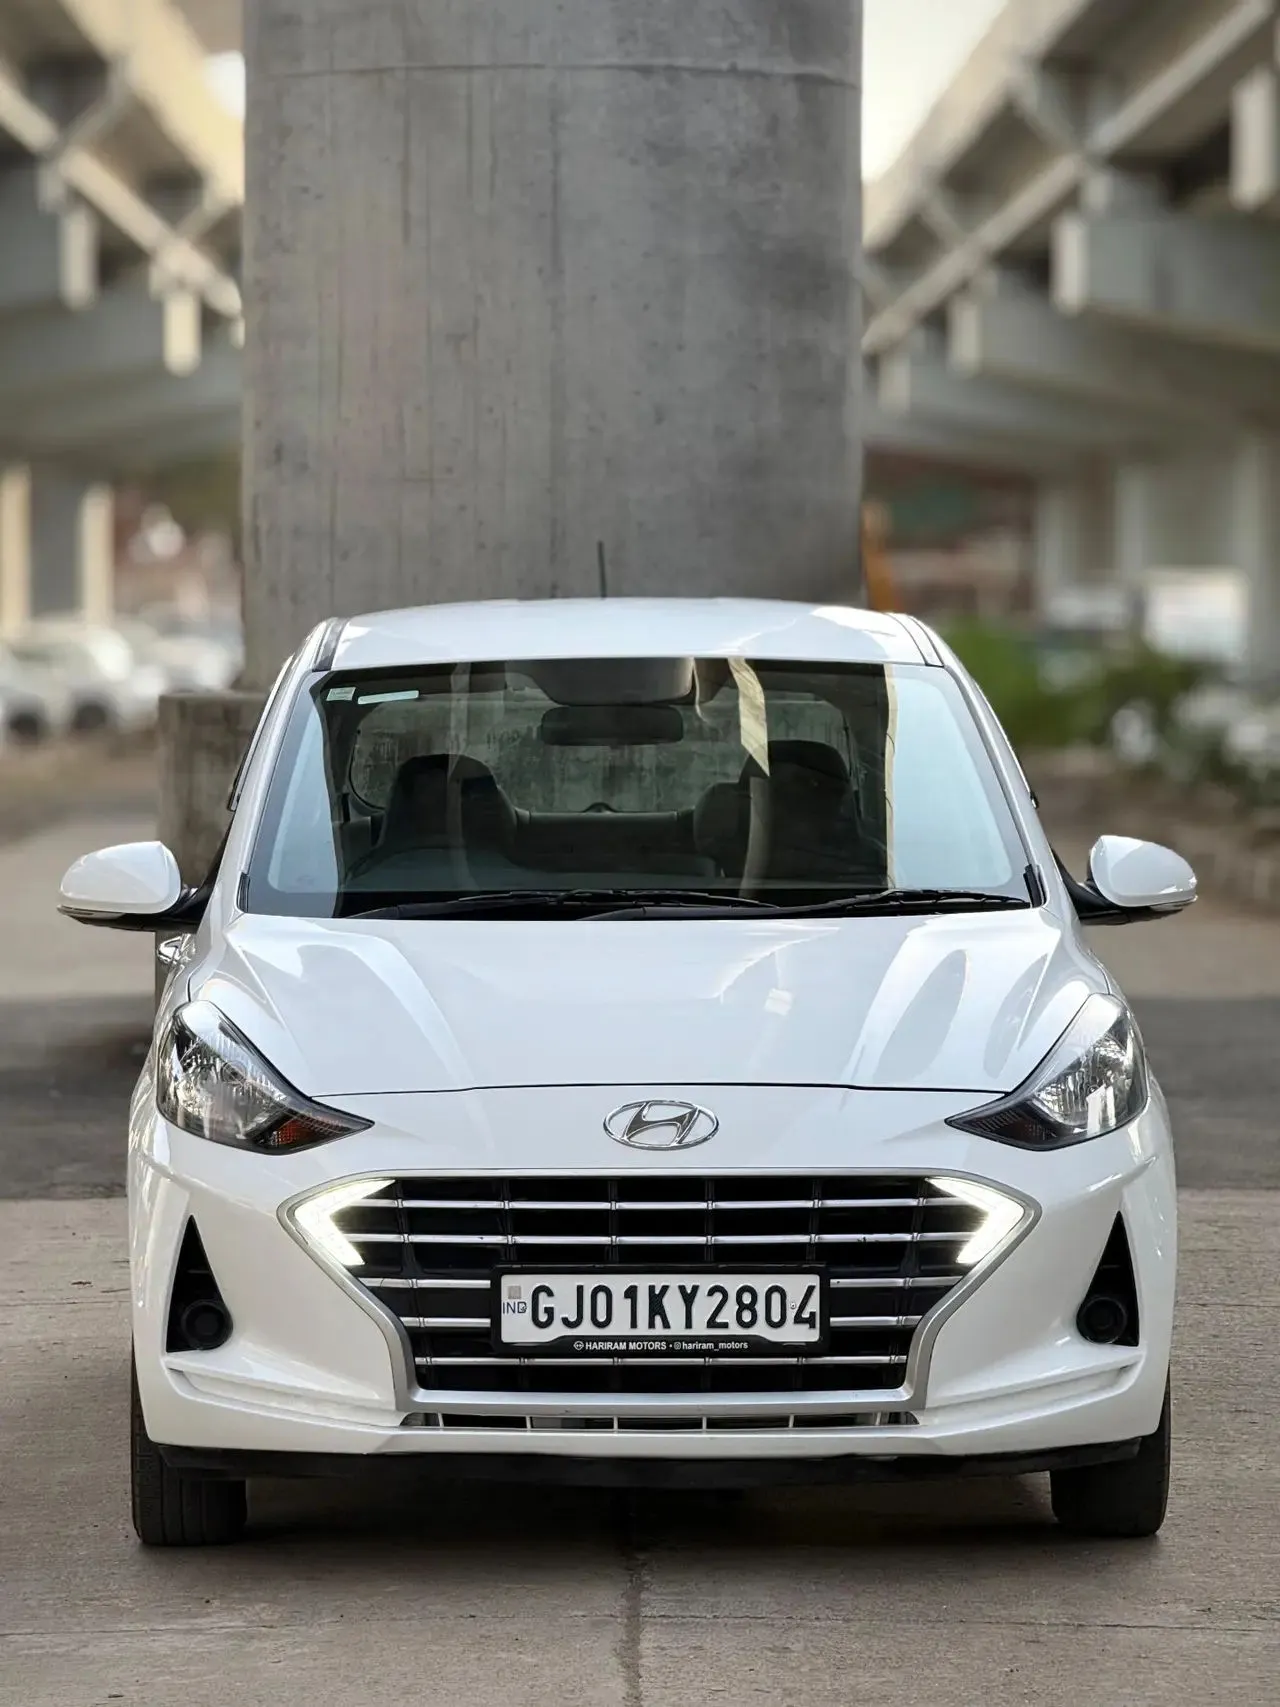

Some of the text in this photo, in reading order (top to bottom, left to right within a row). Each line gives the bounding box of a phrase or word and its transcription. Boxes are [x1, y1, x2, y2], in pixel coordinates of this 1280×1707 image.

[502, 1301, 528, 1314] IND
[531, 1284, 817, 1330] GJ01KY2804
[585, 1341, 627, 1350] HARIRAM
[628, 1341, 667, 1350] MOTORS
